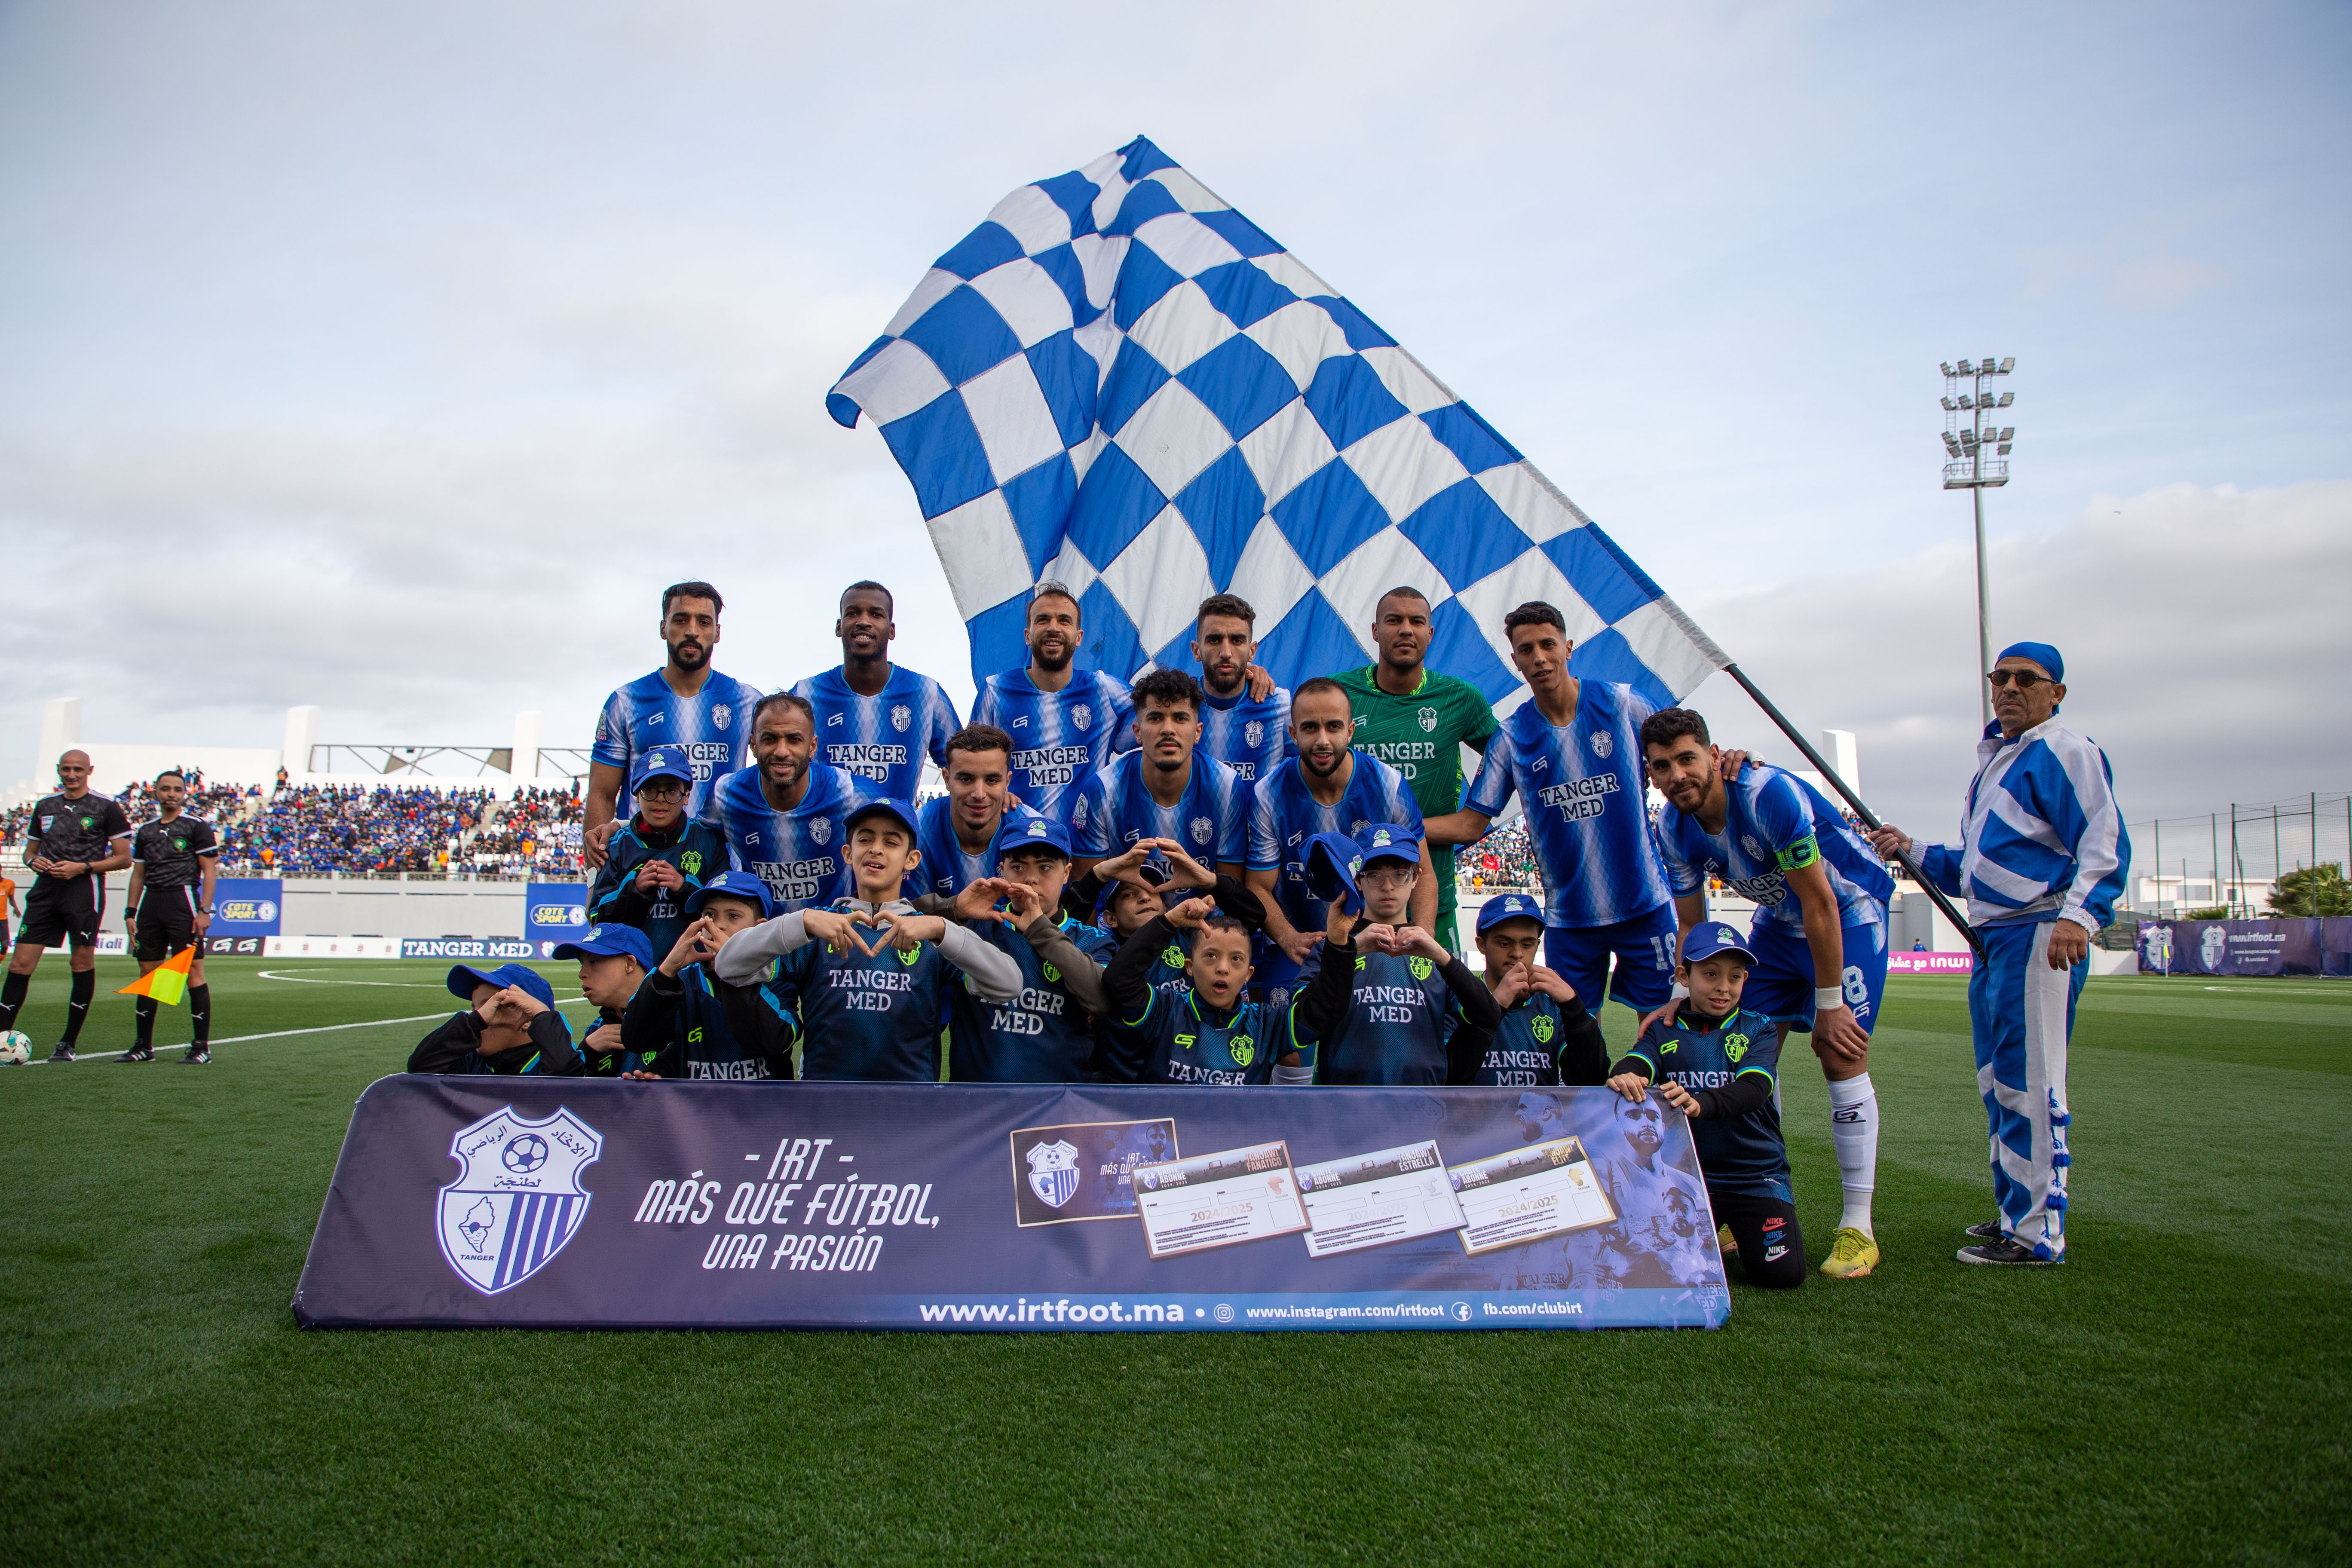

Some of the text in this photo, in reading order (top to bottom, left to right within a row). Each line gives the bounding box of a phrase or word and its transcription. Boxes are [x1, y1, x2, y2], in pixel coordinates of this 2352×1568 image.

[650, 743, 728, 761] NGER
[829, 745, 905, 763] TANGER
[1013, 747, 1087, 768] TANGER
[692, 764, 711, 781] ED
[1030, 765, 1072, 785] MED
[1540, 775, 1618, 806] TANGER
[1562, 795, 1604, 821] MED
[1791, 845, 1810, 861] C
[753, 858, 835, 879] TANGER
[774, 880, 818, 900] MED
[404, 941, 533, 957] TANGER MED
[1650, 932, 1676, 971] 18
[829, 970, 911, 991] TANGER
[1842, 965, 1868, 1004] 8
[846, 991, 891, 1011] MED
[1354, 986, 1427, 1006] TANGER
[991, 1010, 1043, 1035] MED
[1369, 1006, 1412, 1023] MED
[687, 1057, 770, 1080] TANGER
[1169, 1060, 1245, 1085] TANGER
[1496, 1071, 1537, 1087] MED
[467, 1125, 508, 1158] الرياضي
[1541, 1144, 1574, 1158] TANJAWI
[767, 1139, 833, 1180] IRT
[1127, 1152, 1140, 1163] IRT
[1245, 1148, 1279, 1162] TANJAWI
[1397, 1148, 1430, 1162] TANJAWI
[1399, 1156, 1435, 1172] ESTRELLA
[1100, 1162, 1118, 1175] MÁS
[1160, 1170, 1186, 1184] ABONNÉ
[1462, 1170, 1488, 1184] ABONNÉ
[1314, 1172, 1340, 1185] ABONNÉ
[634, 1170, 940, 1228] MÁS QUE FÚTBOL,
[1498, 1195, 1559, 1218] 2024/2025
[1190, 1203, 1253, 1222] 2024/2025
[1347, 1202, 1409, 1222] 2024/2025
[1766, 1231, 1782, 1239] NIKE
[702, 1227, 883, 1271] UNA PASIÓN
[1768, 1246, 1785, 1254] NIKE
[920, 1298, 1184, 1322] www.irtfoot.ma
[1246, 1304, 1444, 1320] www.instagram.com/irtfoot
[1483, 1301, 1583, 1316] fb.com/clubirt
